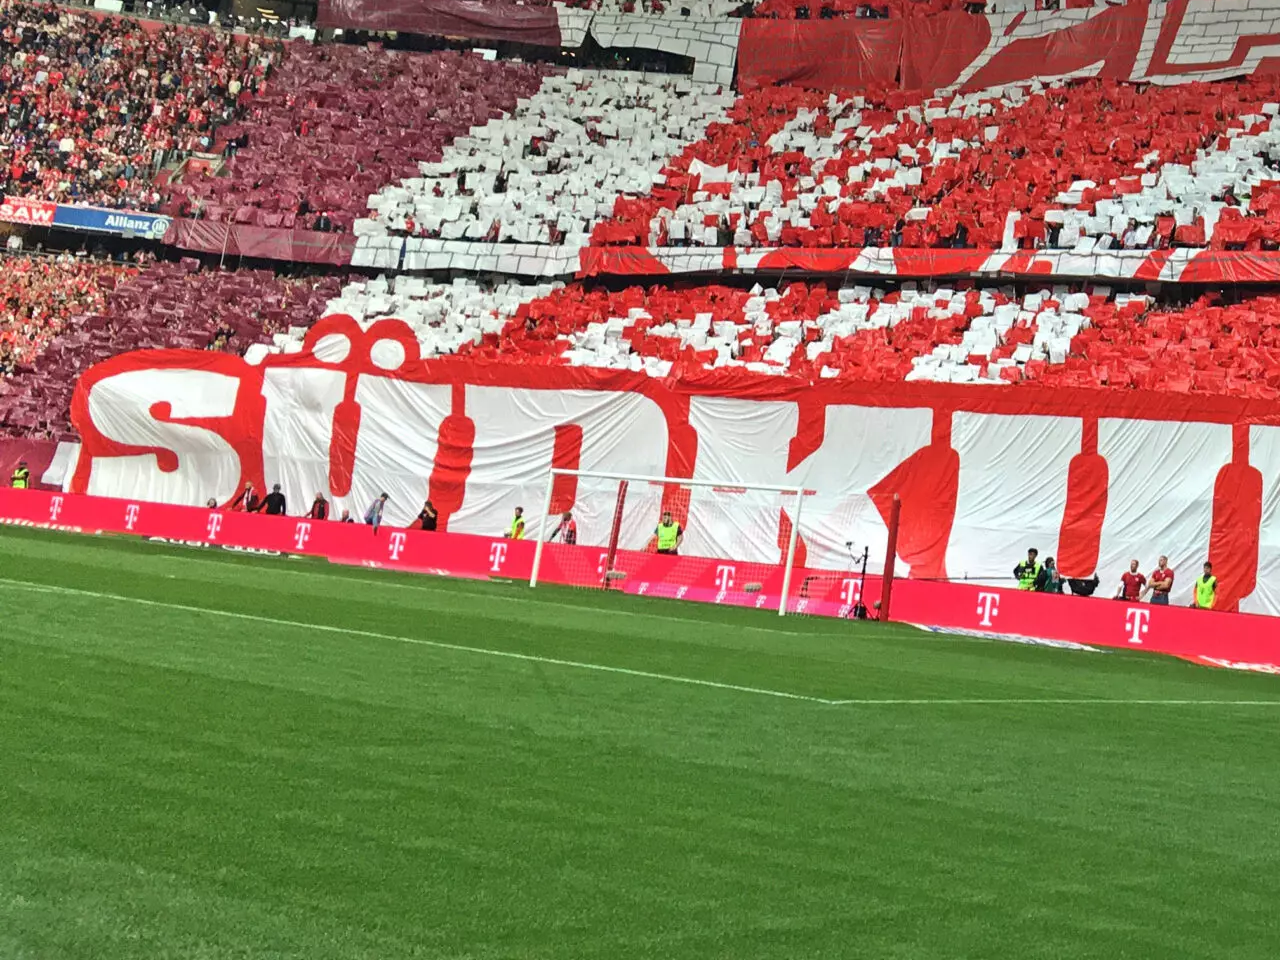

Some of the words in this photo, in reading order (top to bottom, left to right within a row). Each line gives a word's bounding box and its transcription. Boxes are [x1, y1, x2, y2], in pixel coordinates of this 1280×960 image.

[105, 214, 150, 231] Allianz
[50, 496, 64, 520] T
[125, 504, 140, 529] T
[207, 513, 222, 539] T
[294, 522, 311, 549] T
[389, 531, 407, 560] T
[490, 542, 508, 571] T
[715, 565, 736, 592] T
[841, 578, 863, 605] T
[977, 592, 1000, 627] T
[1125, 608, 1150, 644] T
